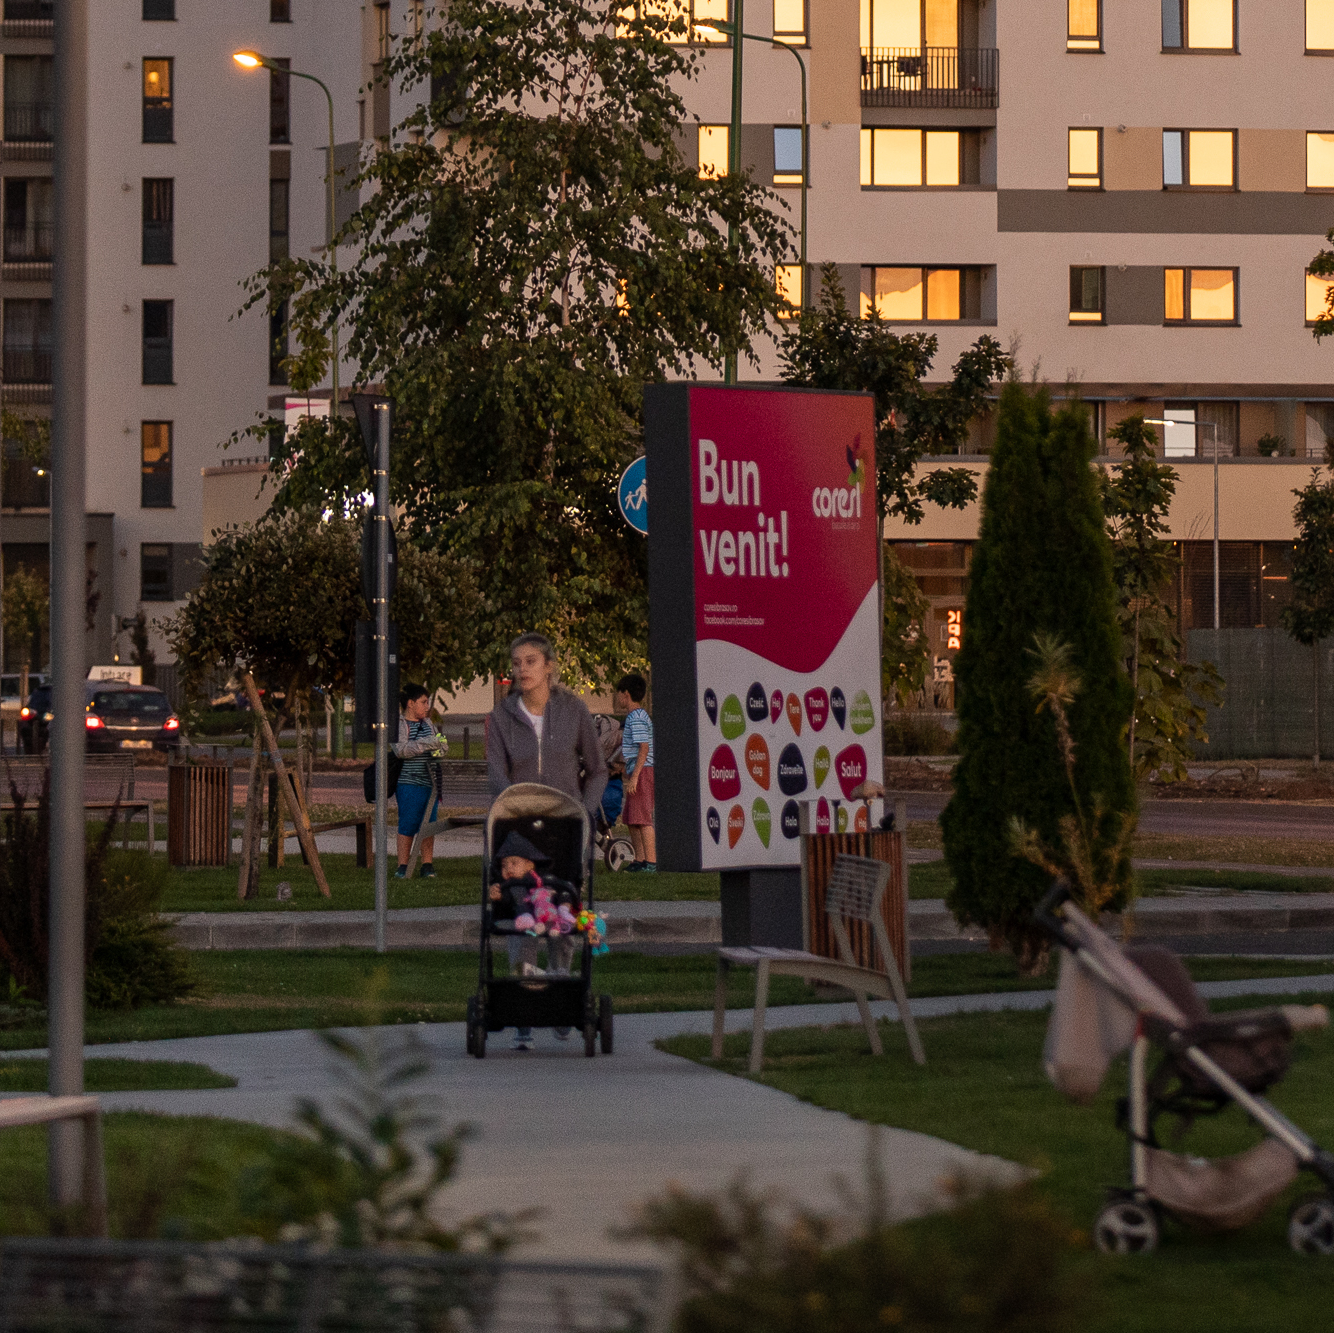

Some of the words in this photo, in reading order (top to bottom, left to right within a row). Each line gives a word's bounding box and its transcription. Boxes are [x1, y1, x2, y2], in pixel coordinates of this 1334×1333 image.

[698, 439, 761, 506] Bun
[699, 510, 789, 578] venit!
[808, 697, 825, 708] Thank
[831, 697, 845, 708] Hello
[812, 714, 822, 724] you
[711, 765, 736, 783] Bonjour
[841, 760, 862, 778] Salut
